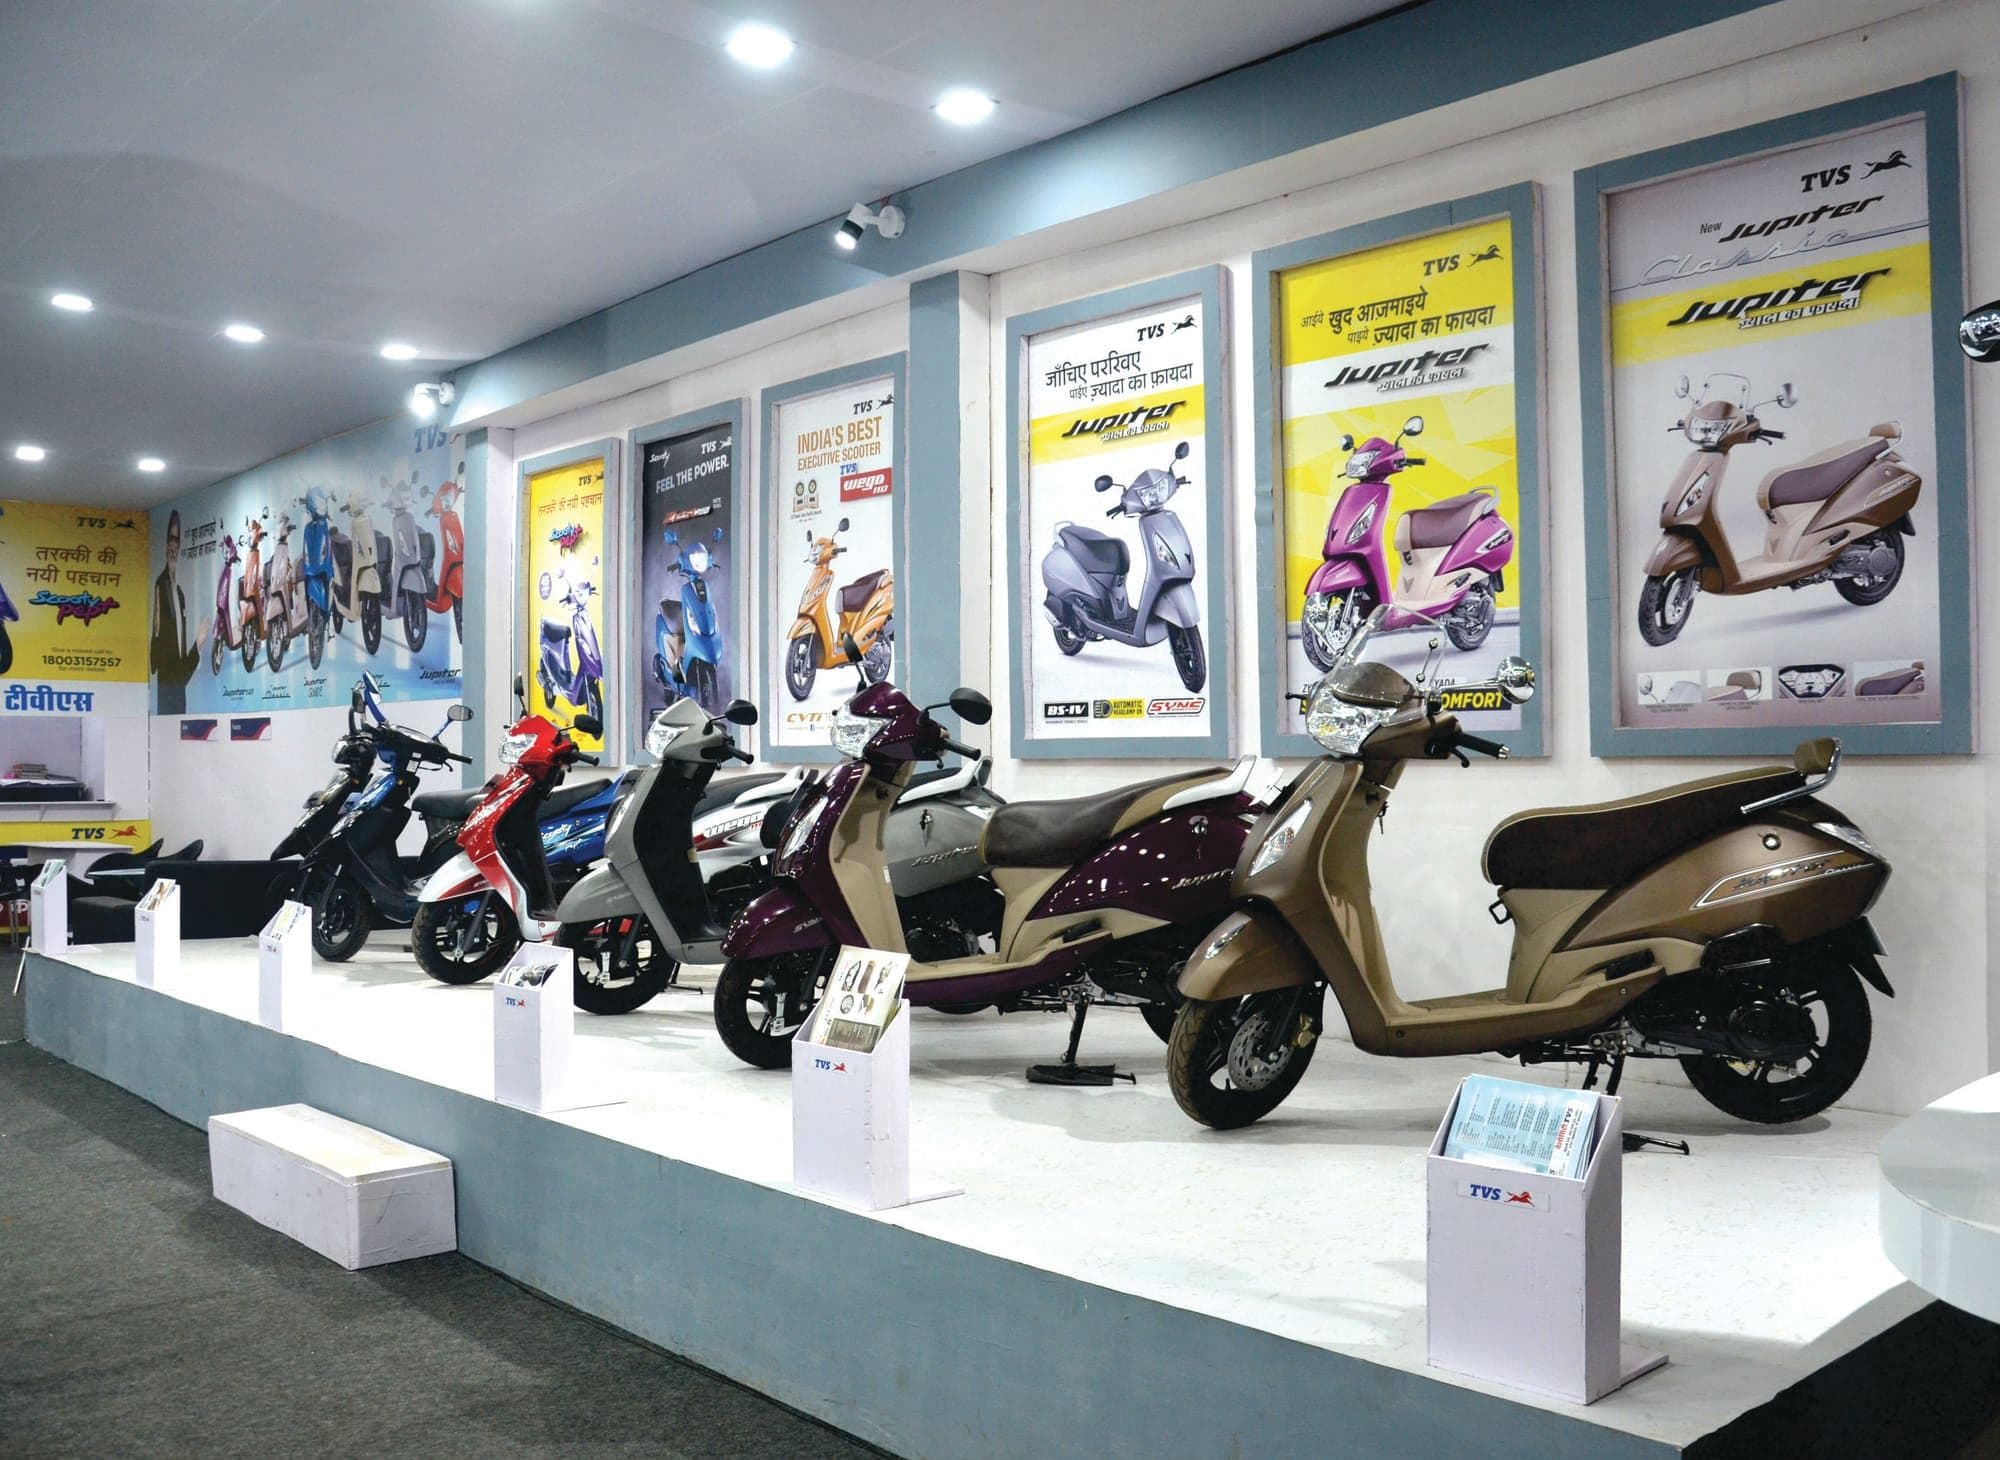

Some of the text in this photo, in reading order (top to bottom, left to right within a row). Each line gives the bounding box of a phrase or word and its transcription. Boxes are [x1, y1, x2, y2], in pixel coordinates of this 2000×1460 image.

[1801, 164, 1851, 193] TVS
[1700, 196, 1885, 243] New Jupiter
[1424, 254, 1460, 276] TVS
[1640, 228, 1850, 284] Classic
[1667, 268, 1892, 327] Jupiter
[1328, 307, 1354, 334] खुद
[1373, 320, 1416, 346] ज़्यादा
[1420, 316, 1442, 336] का
[1445, 305, 1496, 331] फायदा
[1137, 323, 1165, 342] TVS
[1045, 361, 1088, 388] जाँचिए
[1324, 343, 1490, 388] Jupiter
[1090, 378, 1126, 401] ज़्यादा
[1128, 373, 1149, 391] का
[1150, 363, 1194, 389] फ़ायदा
[853, 400, 873, 415] TVS
[1062, 400, 1187, 438] Jupiter
[797, 416, 882, 454] INDIA'S BEST
[701, 440, 717, 454] TVS
[797, 441, 881, 471] EXECUTIVE SCOOTER
[656, 454, 729, 494] FEEL THE POWER.
[840, 463, 857, 475] TVS
[579, 475, 592, 486] TVS
[843, 473, 885, 491] wego
[77, 516, 107, 529] TVS
[35, 544, 118, 566] तरक्की की
[26, 563, 122, 588] नयी पहचान
[28, 590, 102, 608] Scooty
[42, 655, 122, 668] 18003157557
[4, 684, 95, 713] टीवीएस
[1113, 700, 1142, 709] AUTOMATIC
[1150, 701, 1202, 711] SYNC
[1440, 692, 1503, 709] OMFORT
[1047, 705, 1086, 716] BS-IV
[71, 828, 105, 840] TVS
[815, 1059, 831, 1070] TVS
[1564, 1107, 1574, 1124] TVS
[1470, 1184, 1501, 1200] TVS
